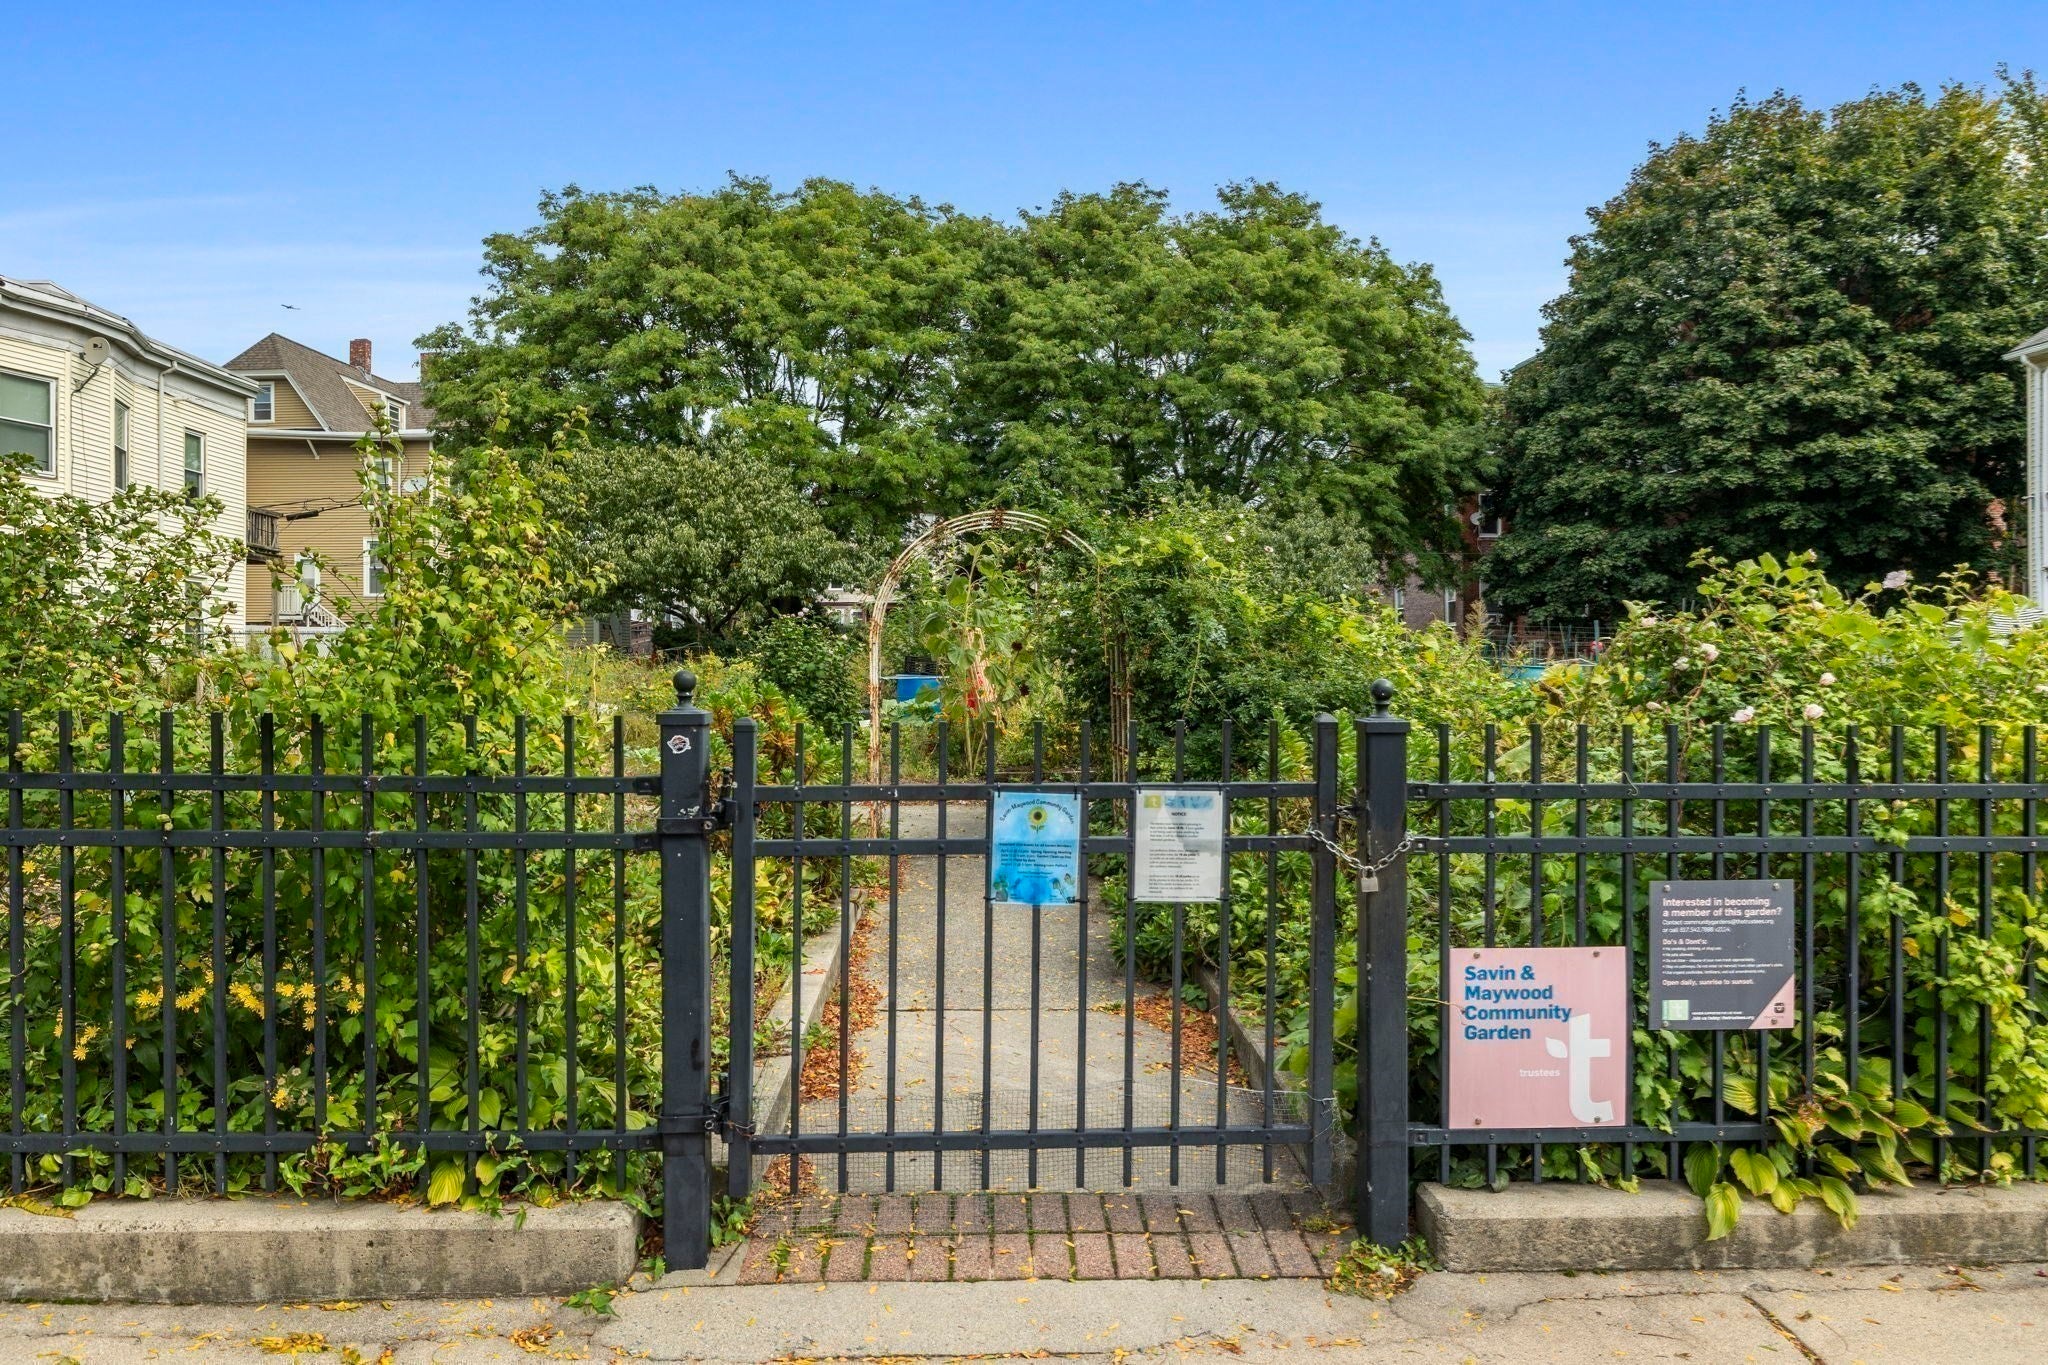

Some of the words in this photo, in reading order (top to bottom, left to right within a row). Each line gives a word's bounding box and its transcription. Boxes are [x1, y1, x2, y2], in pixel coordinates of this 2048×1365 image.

[1662, 898, 1711, 906] Interested
[1713, 898, 1722, 906] in
[1724, 897, 1770, 907] becoming
[1671, 908, 1710, 917] member
[1713, 908, 1723, 916] of
[1724, 907, 1742, 916] this
[1744, 907, 1782, 917] garden?
[1465, 965, 1515, 980] Savin
[1520, 965, 1535, 980] &
[1662, 979, 1679, 987] Open
[1465, 984, 1553, 1003] Maywood
[1464, 1004, 1572, 1022] Community
[1464, 1025, 1531, 1040] Garden
[1519, 1068, 1560, 1077] trustees
